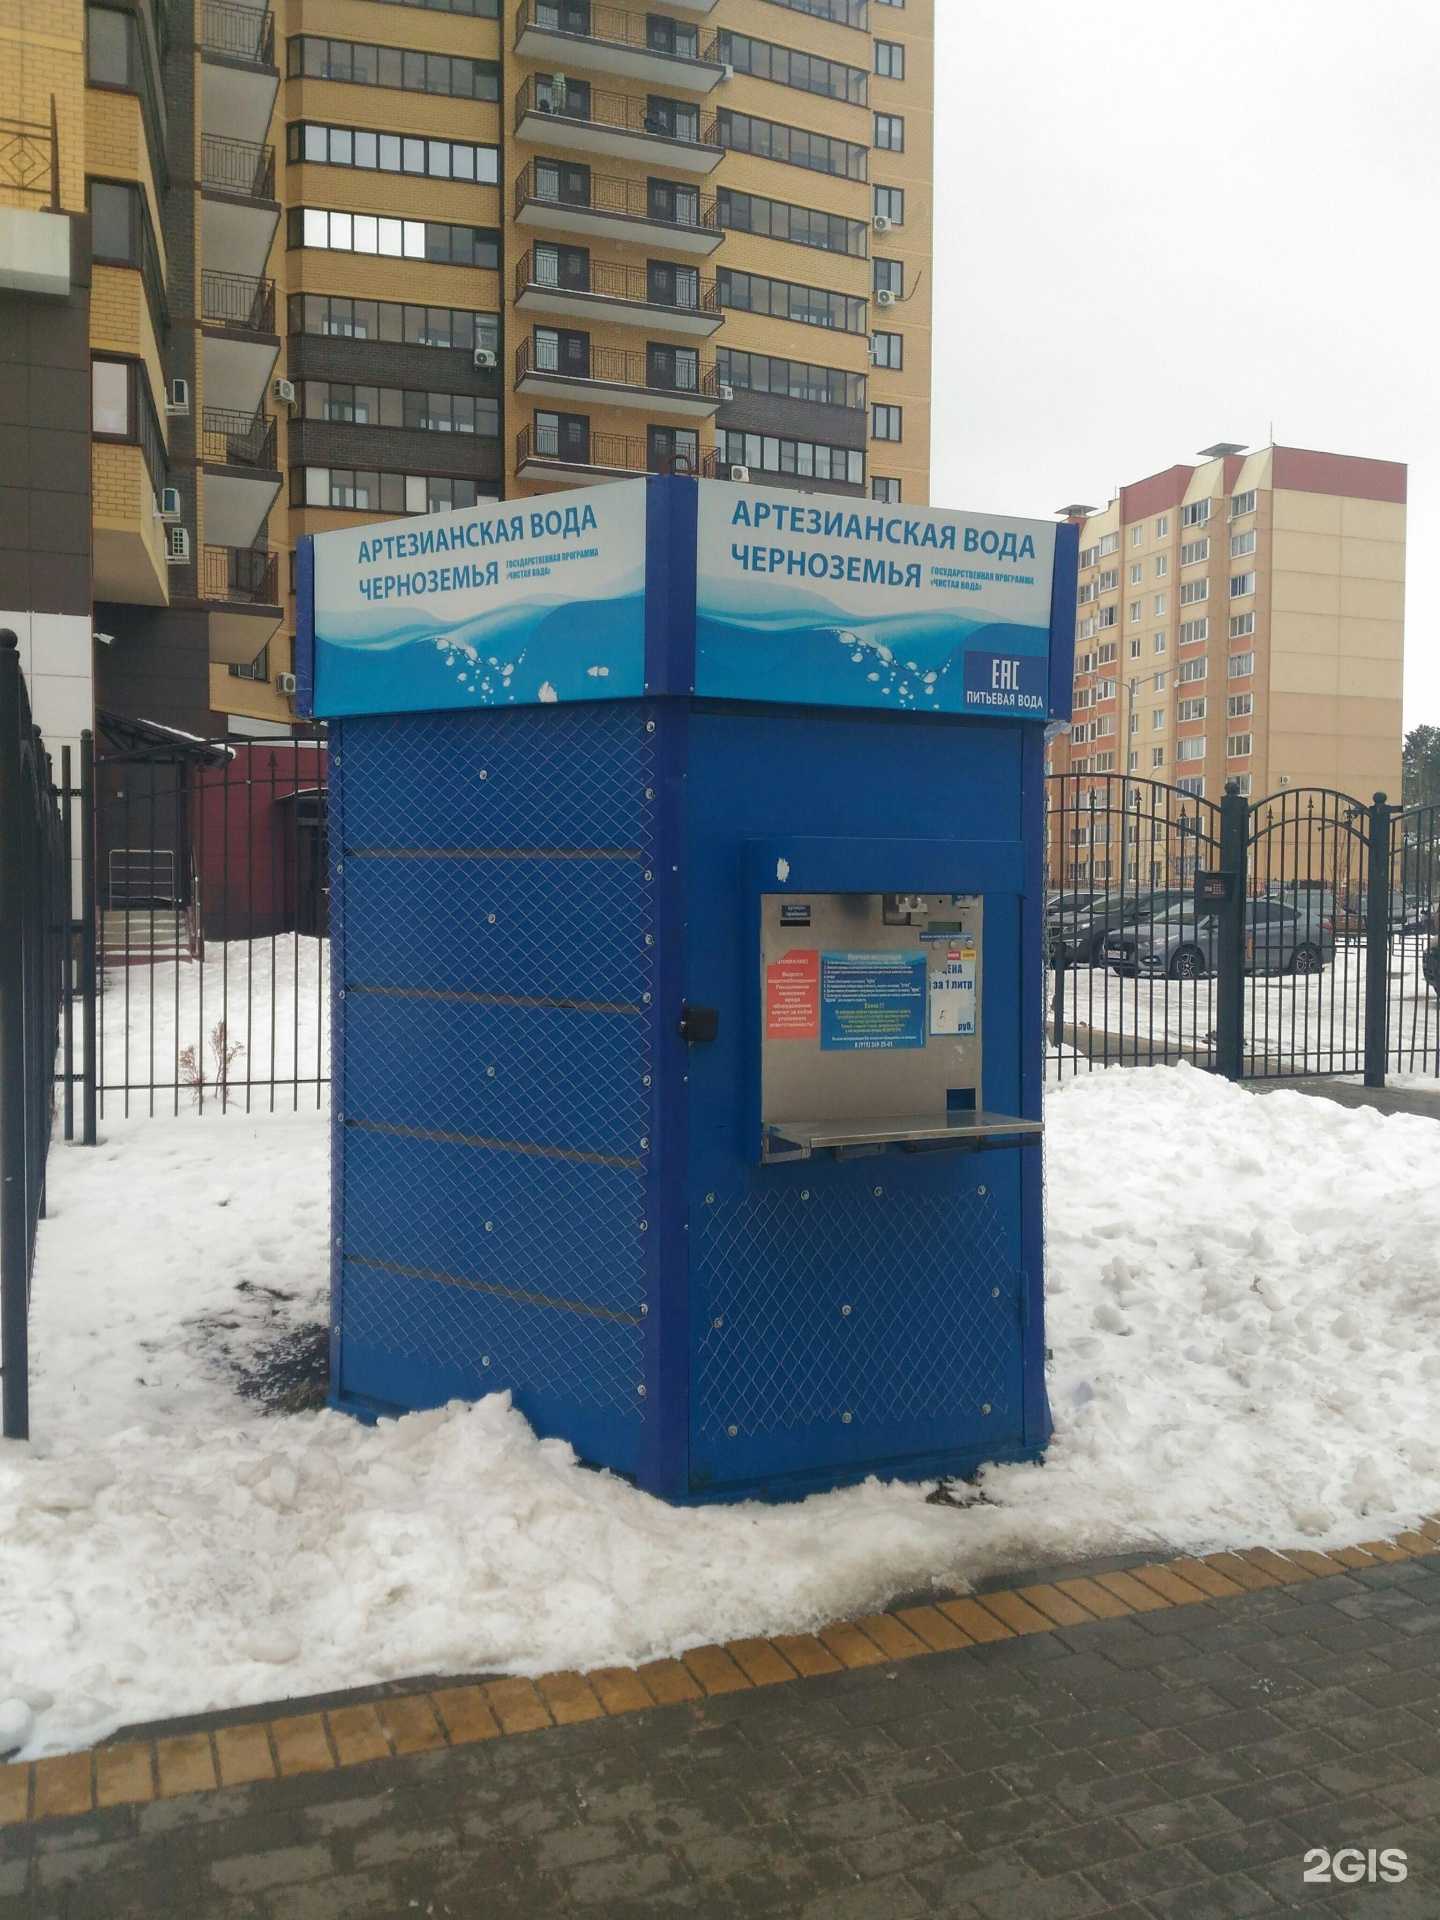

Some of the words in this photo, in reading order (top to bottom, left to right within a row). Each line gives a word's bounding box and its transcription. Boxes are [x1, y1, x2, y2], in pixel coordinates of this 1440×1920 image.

[358, 514, 524, 564] АРТЕЗИАНСКАЯ
[530, 504, 598, 539] ВОДА
[731, 500, 956, 550] АРТЕЗИАНСКАЯ
[962, 527, 1036, 562] ВОДА
[561, 547, 599, 561] ПРОГРАММА
[731, 543, 921, 588] ЧЕРНОЗЕМЬЯ
[359, 561, 499, 600] ЧЕРНОЗЕМЬЯ
[930, 566, 994, 581] ГОСУДАРСТВЕННАЯ
[994, 572, 1035, 585] ПРОГРАММА
[966, 690, 1015, 706] ПИТЬЕВАЯ
[1018, 694, 1044, 709] ВОДА
[933, 981, 943, 989] за
[957, 1021, 973, 1031] руб.
